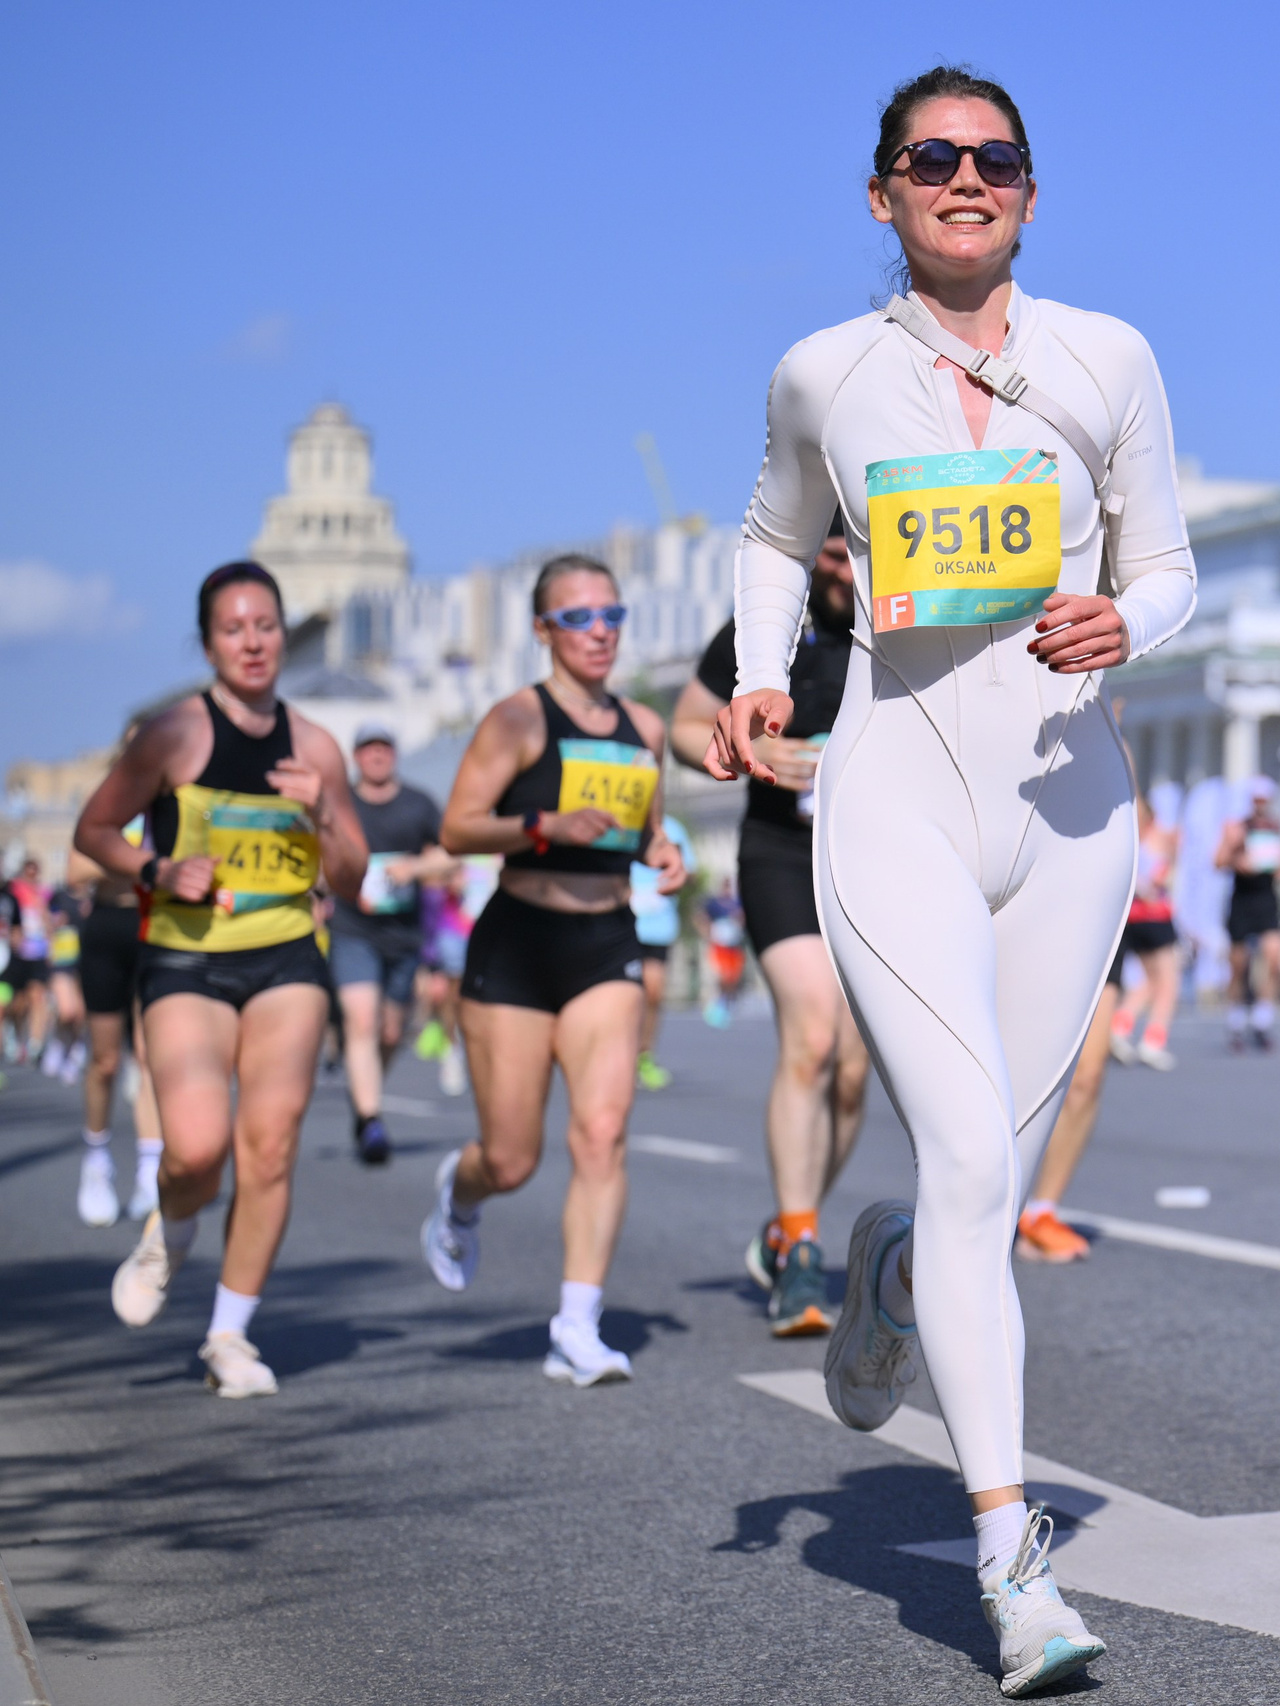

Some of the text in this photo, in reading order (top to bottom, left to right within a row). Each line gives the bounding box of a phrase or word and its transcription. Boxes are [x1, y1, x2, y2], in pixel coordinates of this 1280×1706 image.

[882, 468, 899, 478] 15
[897, 504, 1032, 559] 9518
[934, 560, 997, 575] OKSANA
[890, 595, 908, 625] F
